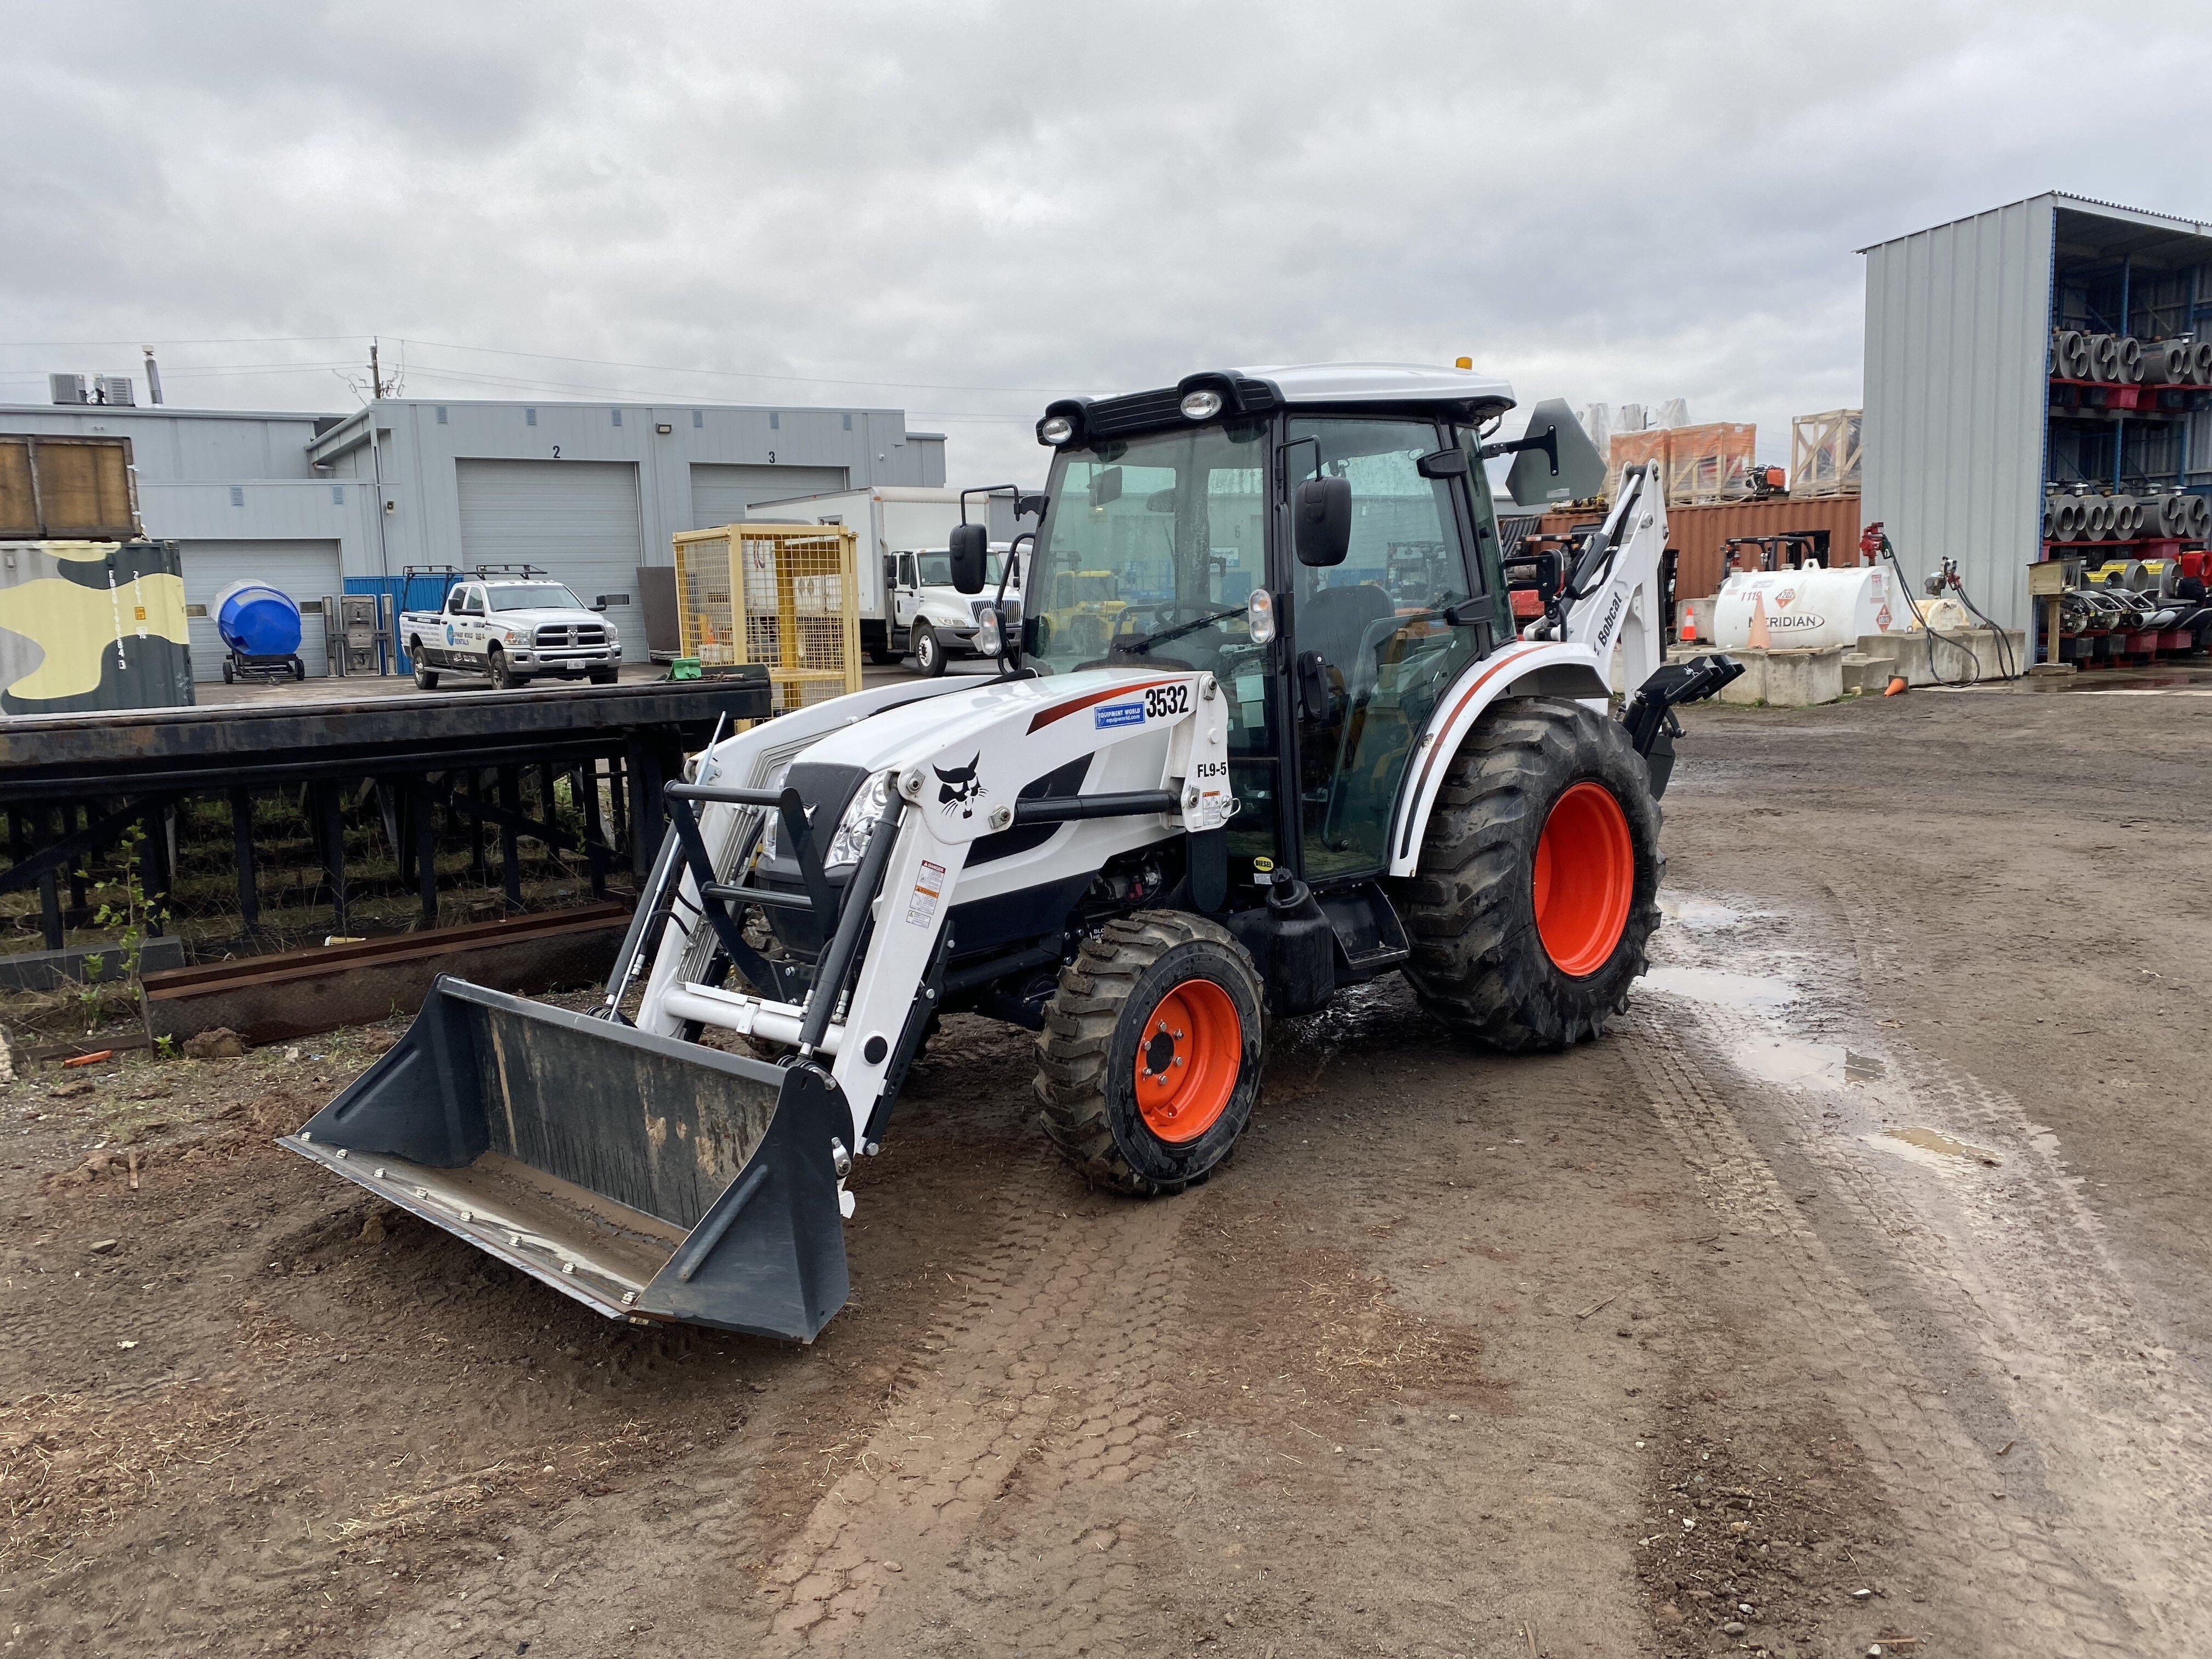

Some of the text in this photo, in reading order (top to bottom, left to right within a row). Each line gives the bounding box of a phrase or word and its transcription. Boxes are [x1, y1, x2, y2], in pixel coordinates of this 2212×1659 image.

[553, 445, 560, 458] 2
[769, 451, 775, 464] 3
[1598, 591, 1622, 647] Bobcat
[1748, 616, 1816, 628] RIDIAN
[1146, 685, 1189, 718] 3532
[1098, 710, 1124, 719] EQUIPMENT
[1106, 714, 1140, 723] equipworld.com
[1198, 761, 1227, 777] FL9-5
[1255, 860, 1272, 868] DIESEL
